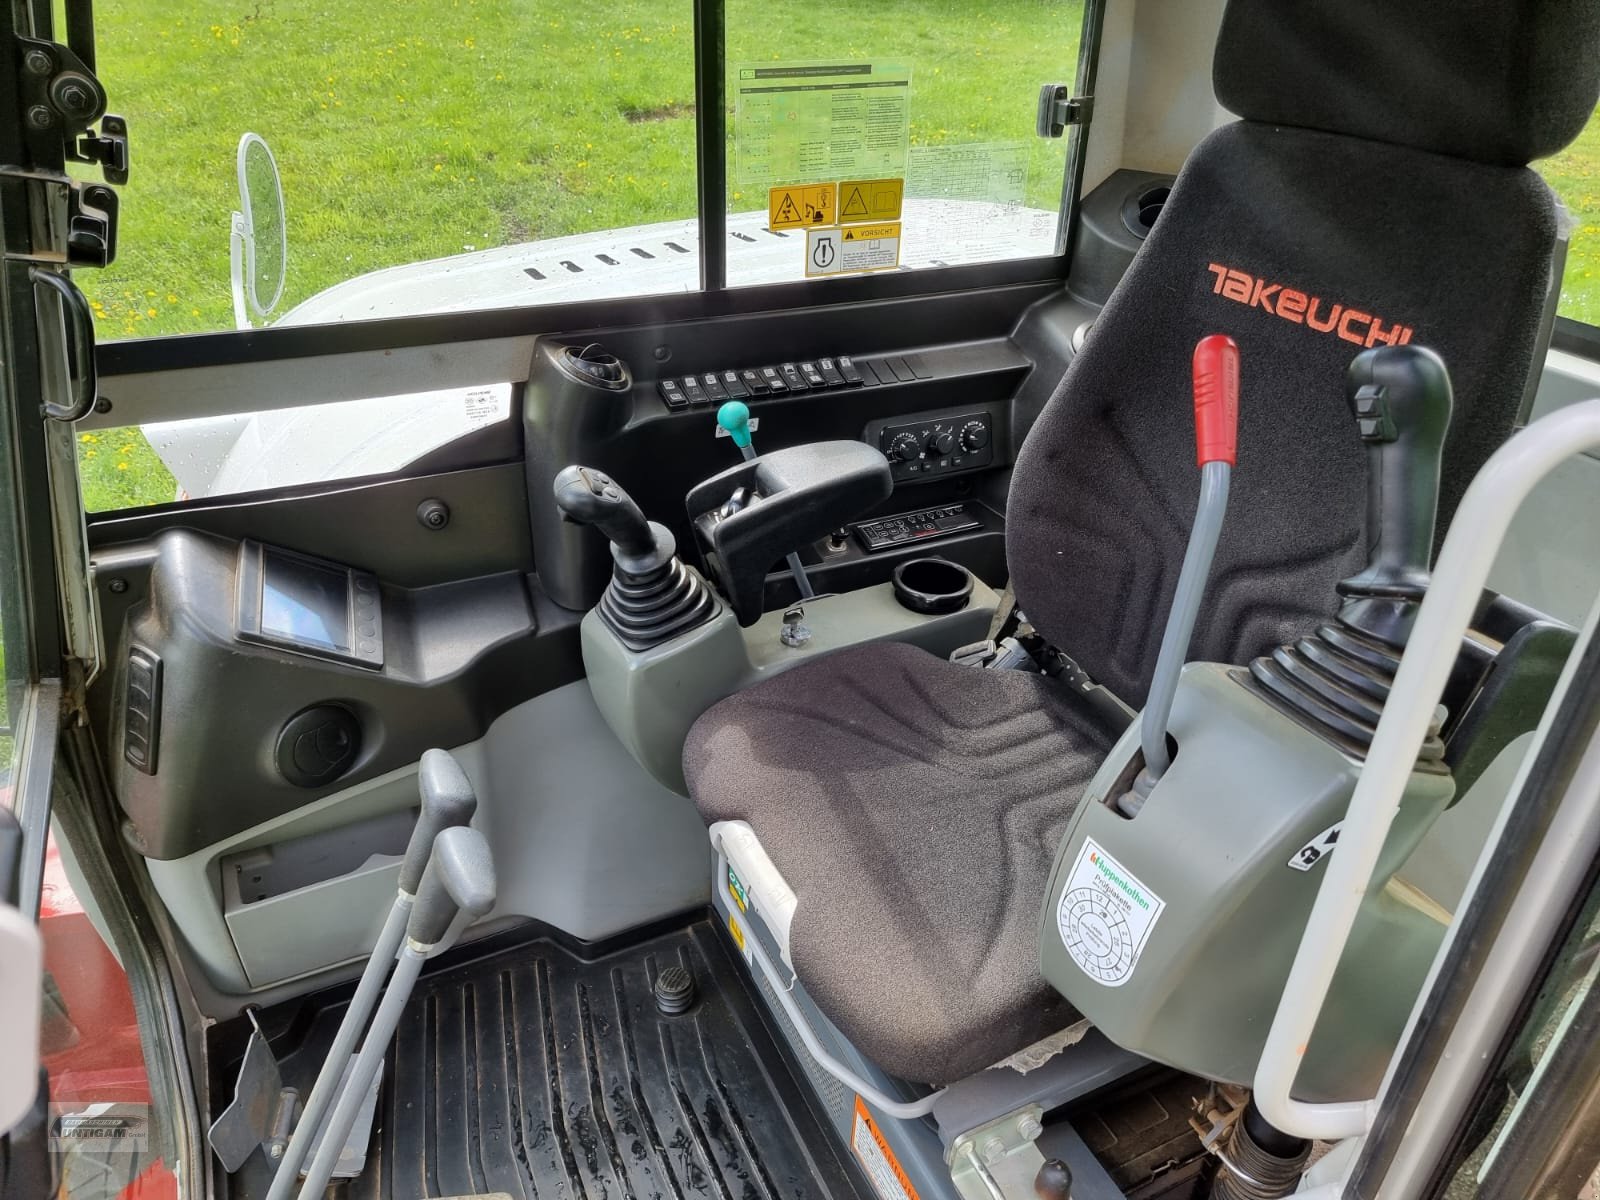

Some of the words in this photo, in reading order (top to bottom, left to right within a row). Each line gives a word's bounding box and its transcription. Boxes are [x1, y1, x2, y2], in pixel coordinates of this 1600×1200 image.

[860, 229, 893, 237] VORSICHT
[1094, 873, 1132, 911] Prüfplakette
[1095, 856, 1150, 911] Huppenkothen
